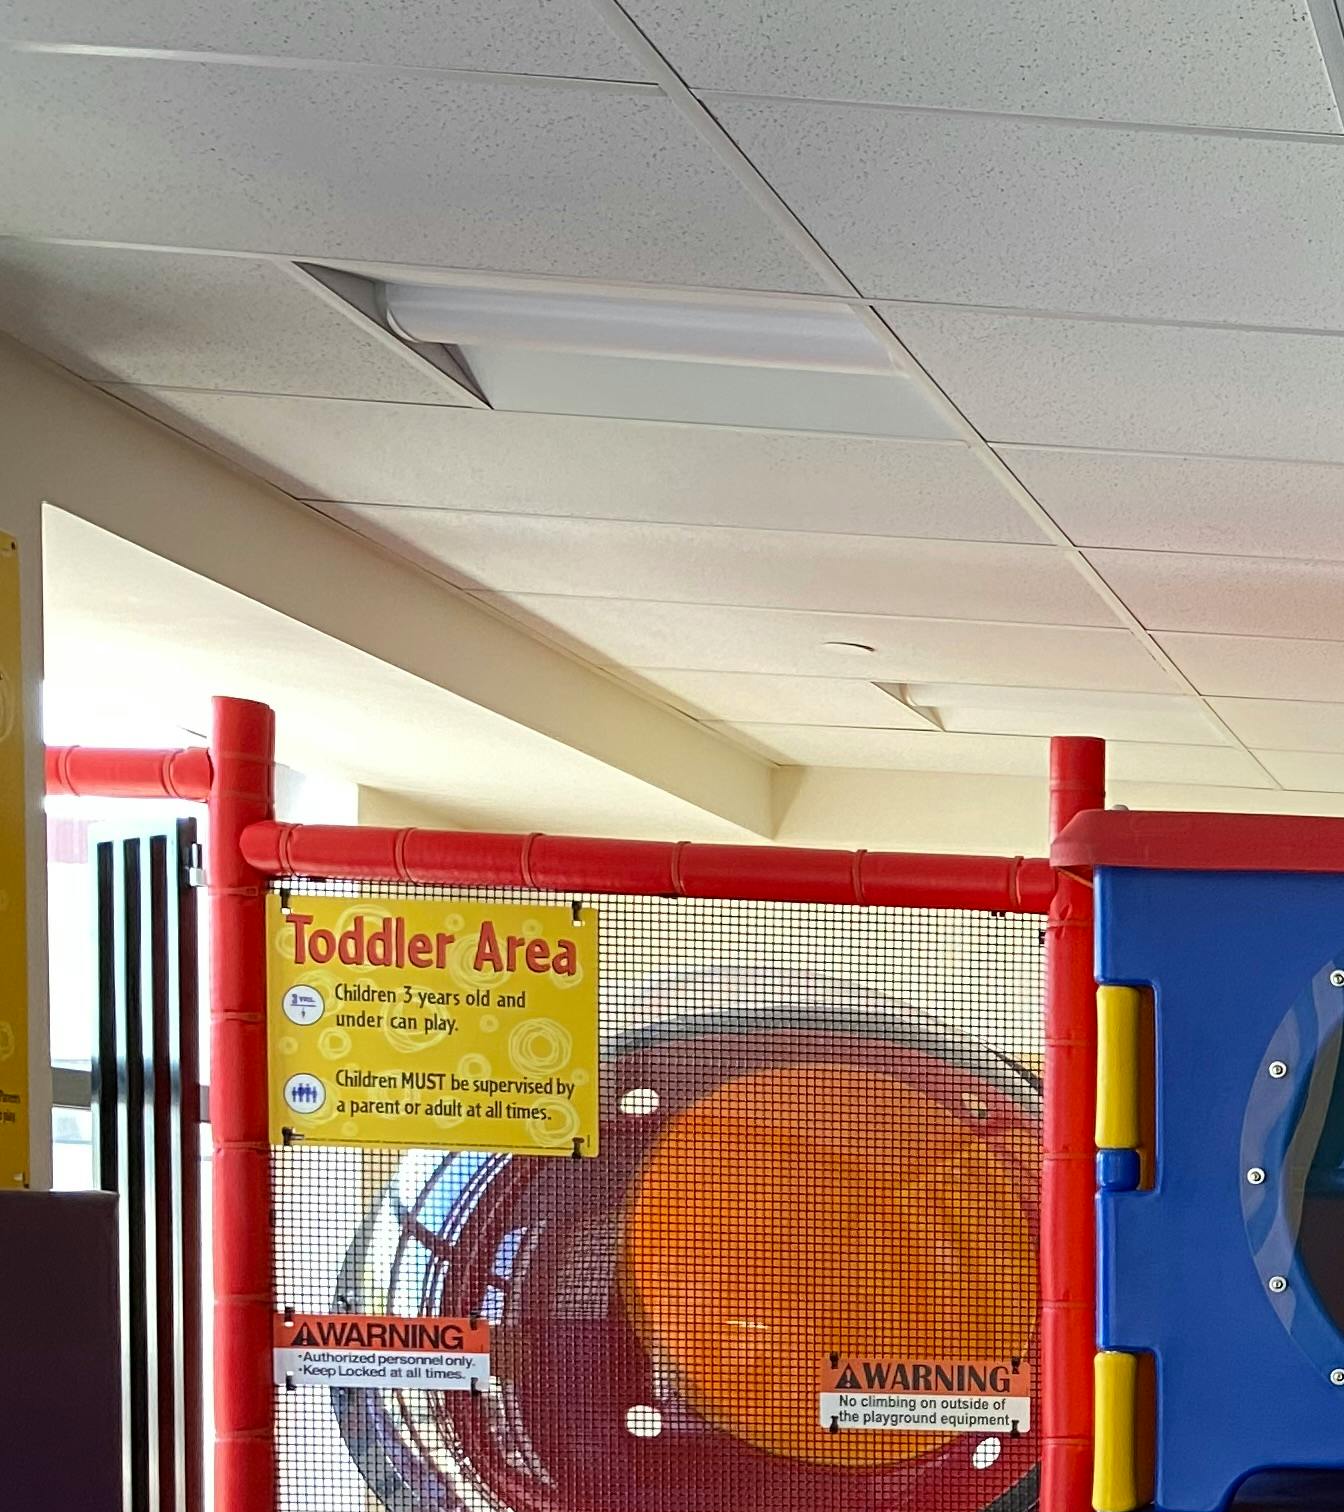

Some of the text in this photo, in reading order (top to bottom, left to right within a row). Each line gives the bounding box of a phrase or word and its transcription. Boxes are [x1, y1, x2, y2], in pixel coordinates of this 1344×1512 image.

[286, 912, 578, 976] Toddler Area
[335, 983, 526, 1009] Children 3 years old and
[336, 1011, 459, 1034] under can play.
[336, 1069, 575, 1099] Children MUST be supervised by
[336, 1098, 552, 1121] a parent or adult at all times.
[317, 1321, 464, 1350] WARNING
[303, 1352, 476, 1370] Authorized personnel only.
[303, 1366, 466, 1380] Keep Locked at all times.
[862, 1362, 1011, 1393] WARNING
[839, 1394, 1006, 1412] No climbing on outside of
[839, 1411, 1010, 1427] the playground equipment
